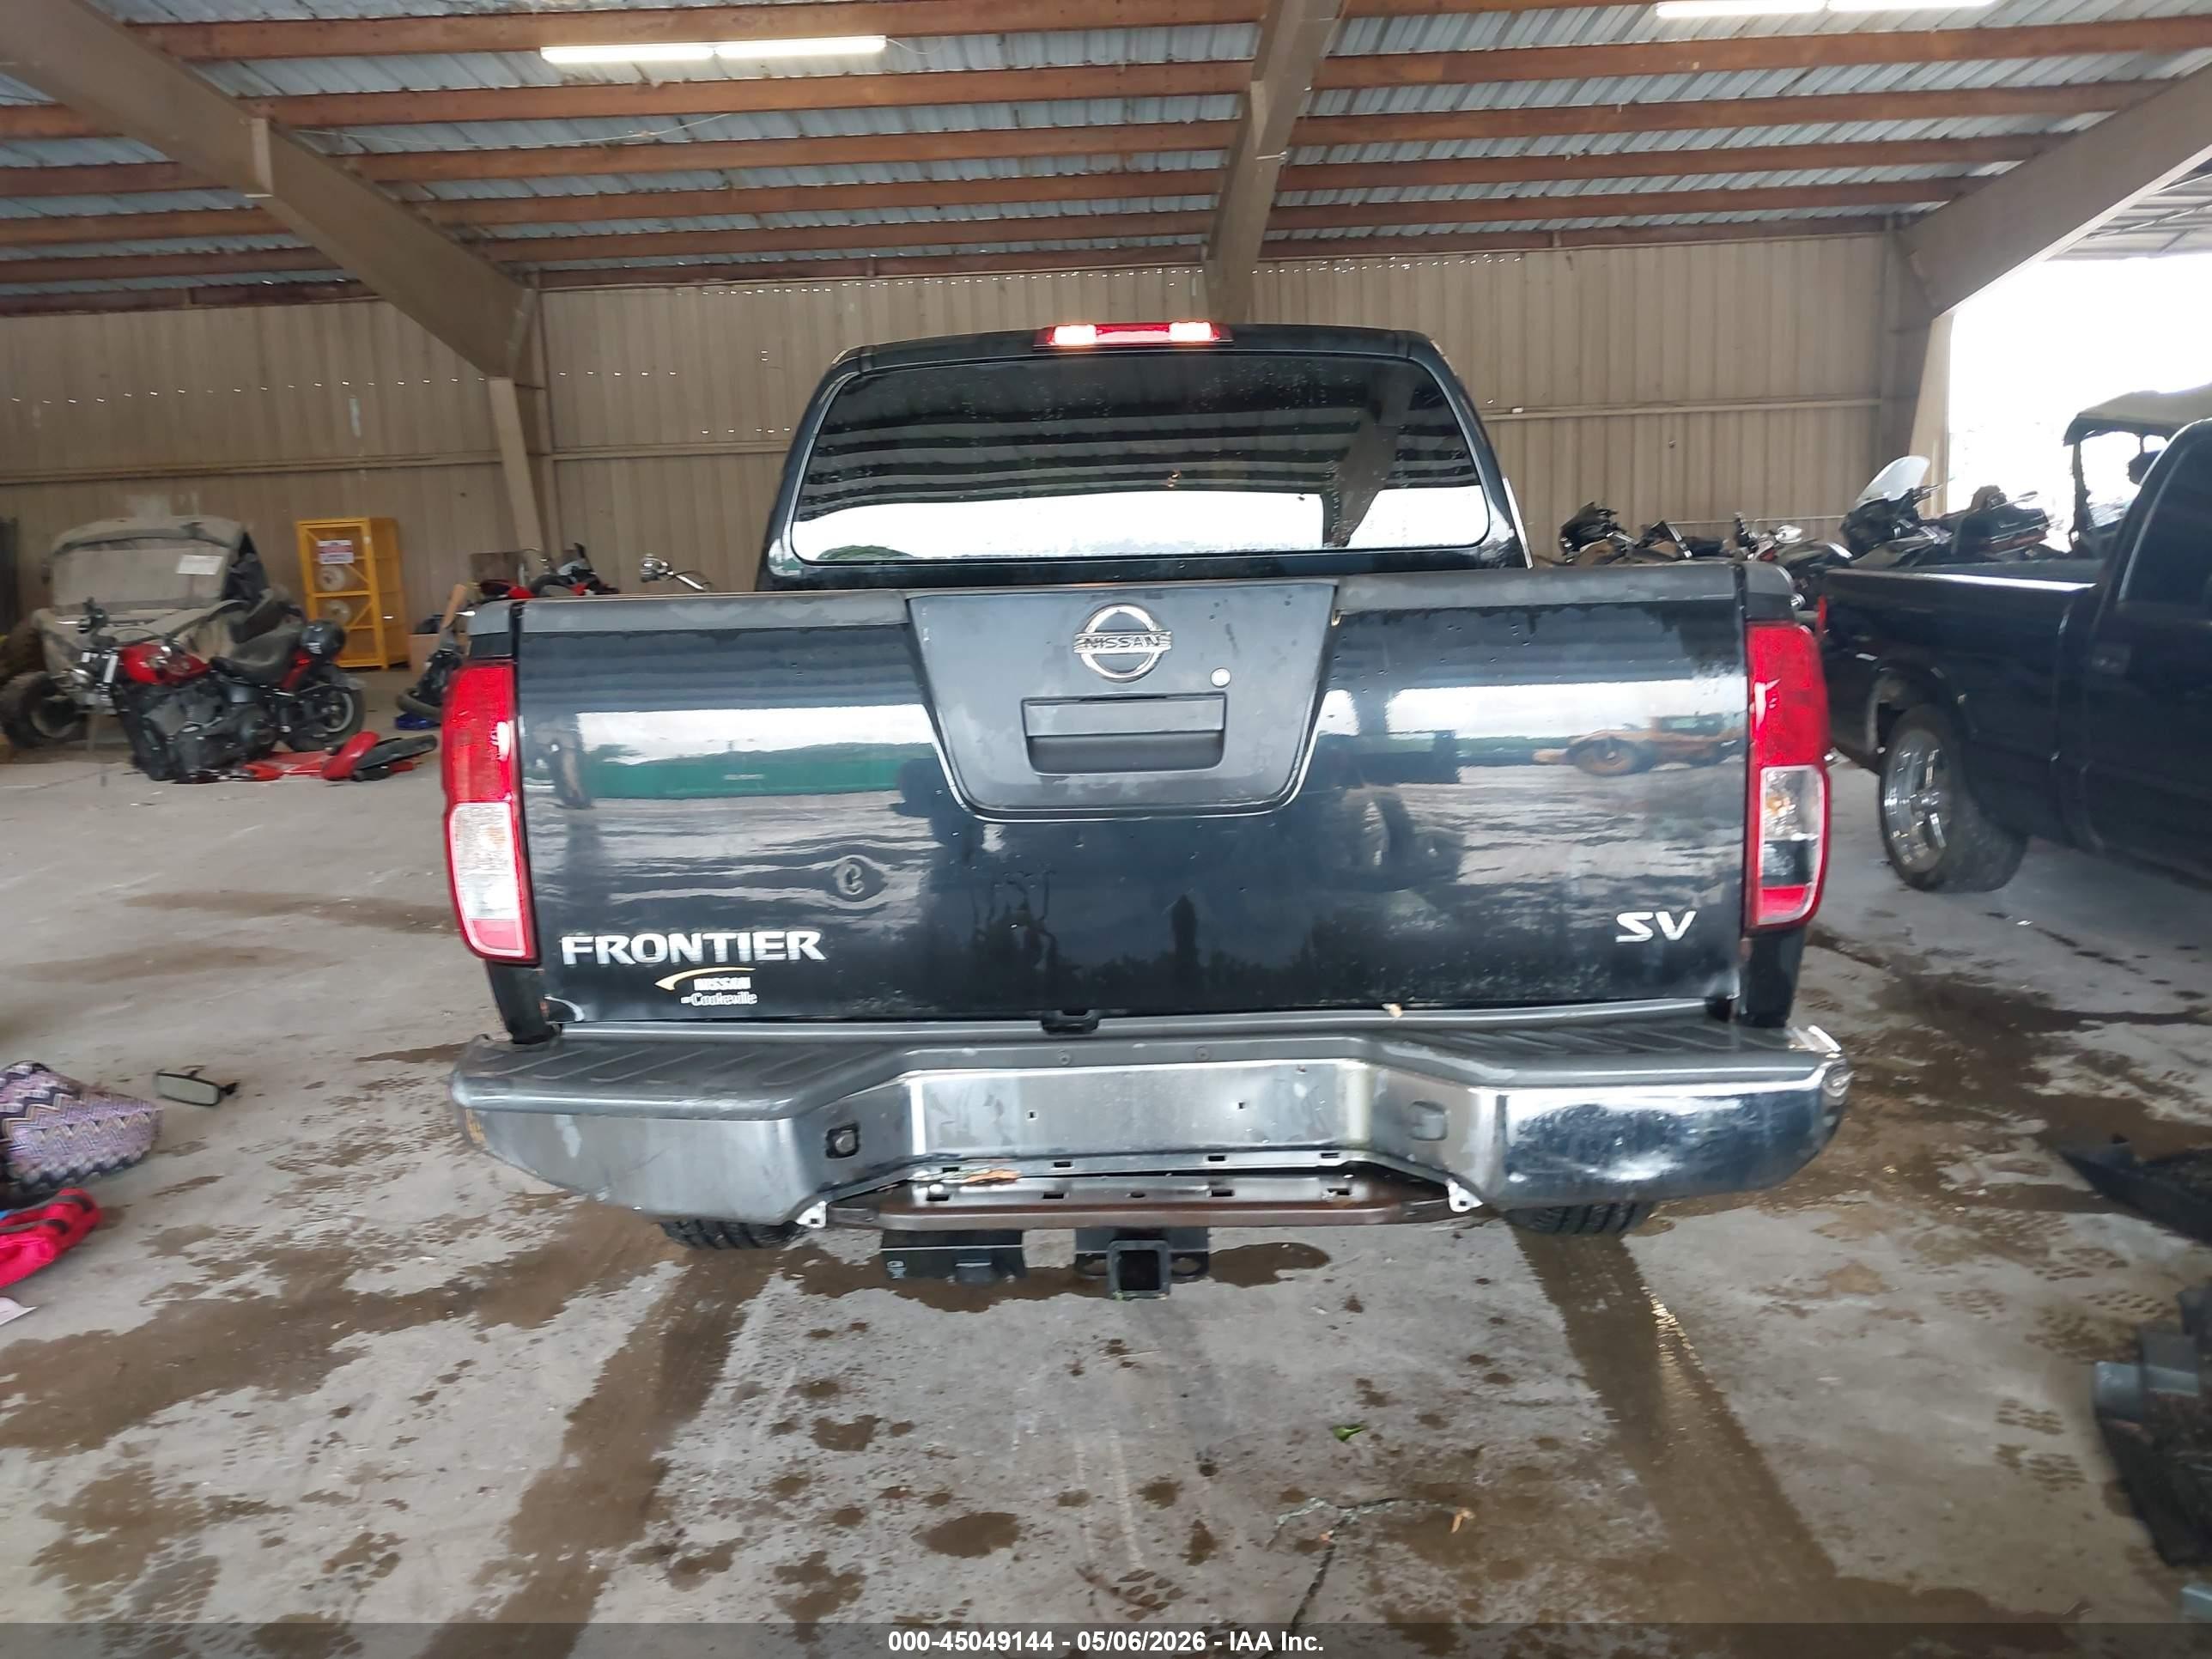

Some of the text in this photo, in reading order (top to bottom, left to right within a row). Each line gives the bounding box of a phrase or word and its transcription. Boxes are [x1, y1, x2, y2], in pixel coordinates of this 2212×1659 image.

[1082, 635, 1163, 649] NISSAN
[1615, 911, 1697, 943] SV
[561, 931, 827, 965] FRONTIER
